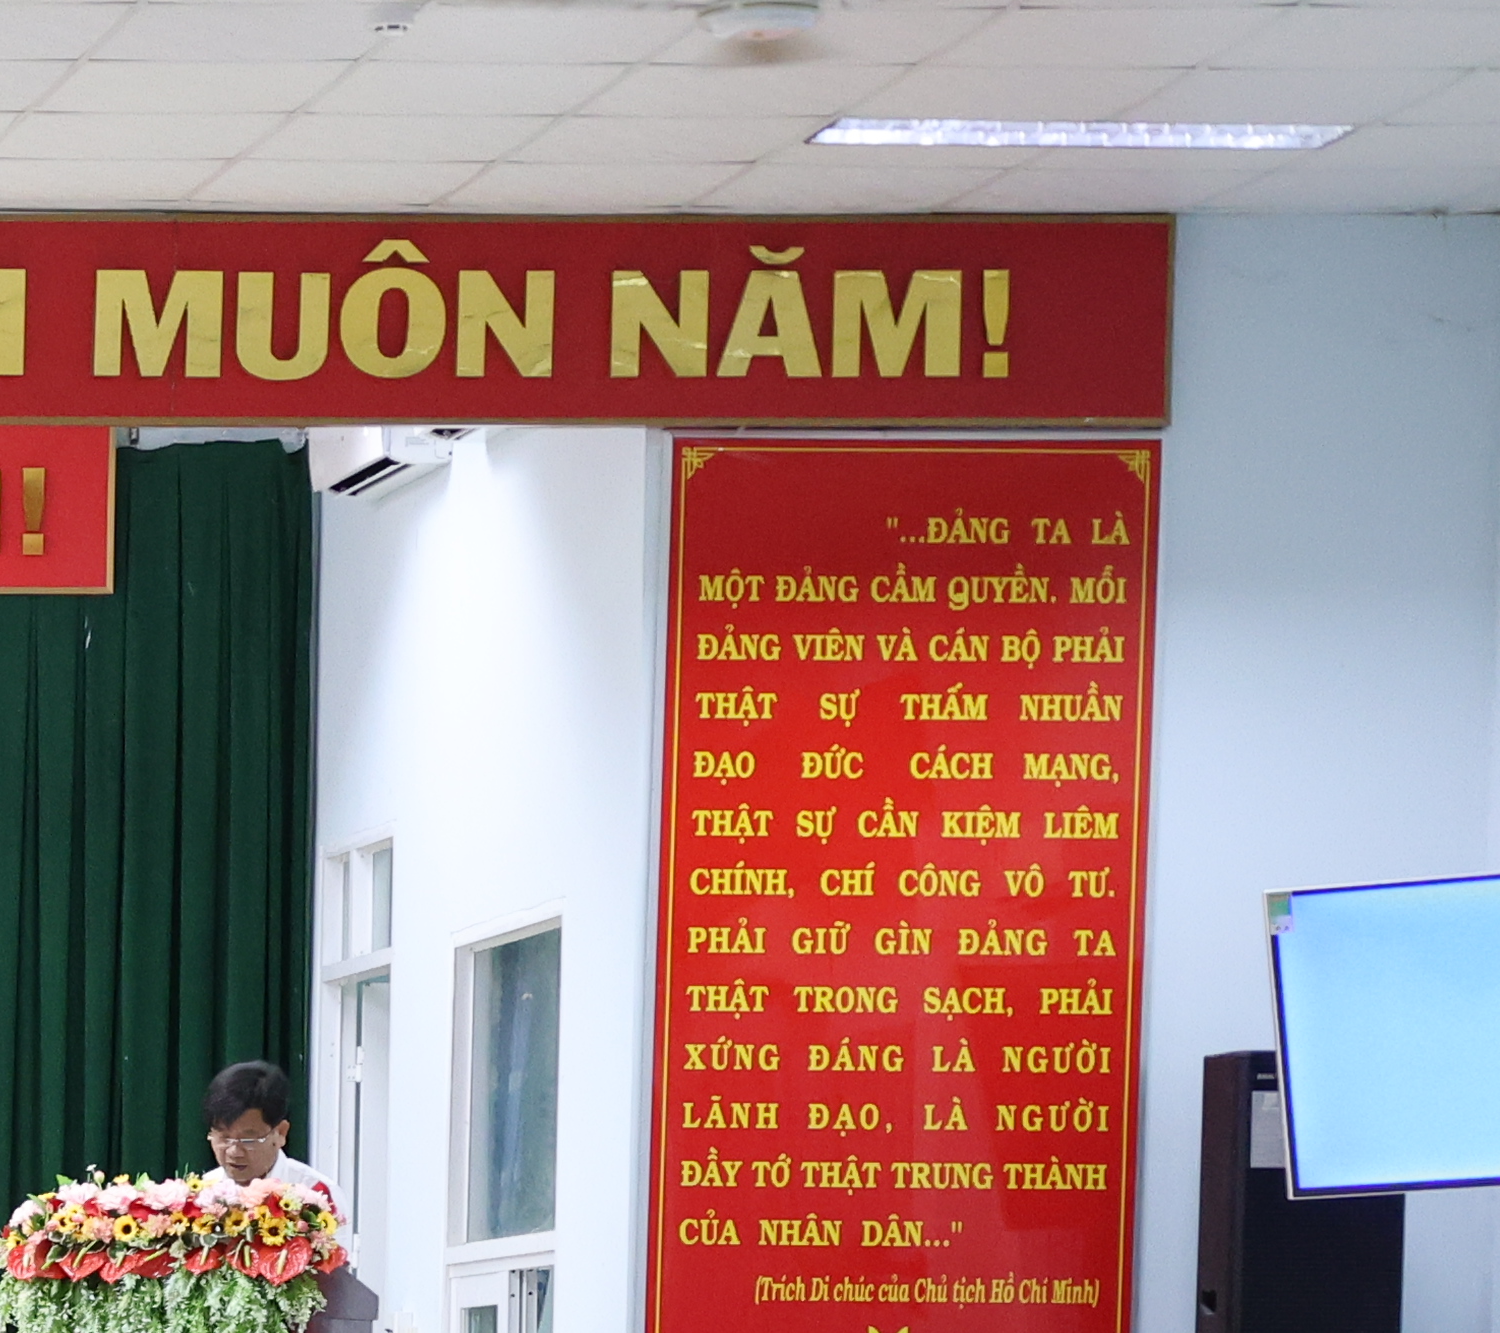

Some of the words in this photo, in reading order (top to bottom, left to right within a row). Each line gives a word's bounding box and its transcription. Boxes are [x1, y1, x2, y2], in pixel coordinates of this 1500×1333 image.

[93, 239, 555, 381] MUÔN
[610, 245, 1009, 378] NĂM!
[885, 508, 1009, 544] "...ĐẢNG
[1031, 518, 1071, 544] TA
[1091, 511, 1130, 545] LÀ
[698, 568, 765, 609] MỘT
[775, 566, 859, 602] ĐẢNG
[871, 562, 937, 603] CẦM
[948, 563, 1057, 611] QUYỀN.
[1070, 565, 1127, 604] MỖI
[696, 624, 782, 661] ĐẢNG
[792, 627, 865, 661] VIÊN
[876, 626, 918, 662] VÀ
[928, 627, 990, 662] CÁN
[1000, 628, 1041, 669] BỘ
[1052, 626, 1125, 663] PHẢI
[695, 685, 778, 727] THẬT
[819, 688, 861, 728] SỰ
[899, 682, 989, 721] THẤM
[1019, 680, 1124, 722] NHUẦN
[693, 750, 756, 786] ĐẠO
[801, 743, 864, 780] ĐỨC
[909, 744, 994, 780] CÁCH
[1022, 752, 1119, 788] MẠNG,
[683, 1035, 780, 1071] XỨNG
[807, 1036, 904, 1072] ĐÁNG
[931, 1037, 976, 1073] LÀ
[1002, 1038, 1111, 1074] NGƯỜI
[682, 1095, 779, 1129] LÃNH
[807, 1103, 892, 1137] ĐẠO,
[923, 1096, 968, 1131] LÀ
[996, 1097, 1109, 1132] NGƯỜI
[680, 1146, 743, 1187] ĐẦY
[751, 1153, 792, 1188] TỚ
[800, 1154, 882, 1196] THẬT
[890, 1162, 994, 1190] TRUNG
[1003, 1155, 1107, 1190] THÀNH
[679, 1208, 741, 1246] CỦA
[758, 1212, 843, 1246] NHÂN
[861, 1213, 963, 1247] DÂN..."
[754, 1274, 806, 1305] (Trích
[808, 1275, 830, 1302] Di
[833, 1275, 875, 1302] chúc
[878, 1273, 910, 1303] của
[914, 1274, 948, 1303] Chủ
[952, 1276, 986, 1309] tịch
[988, 1271, 1015, 1304] Hồ
[1018, 1277, 1048, 1304] Chí
[1050, 1277, 1100, 1308] Minh)
